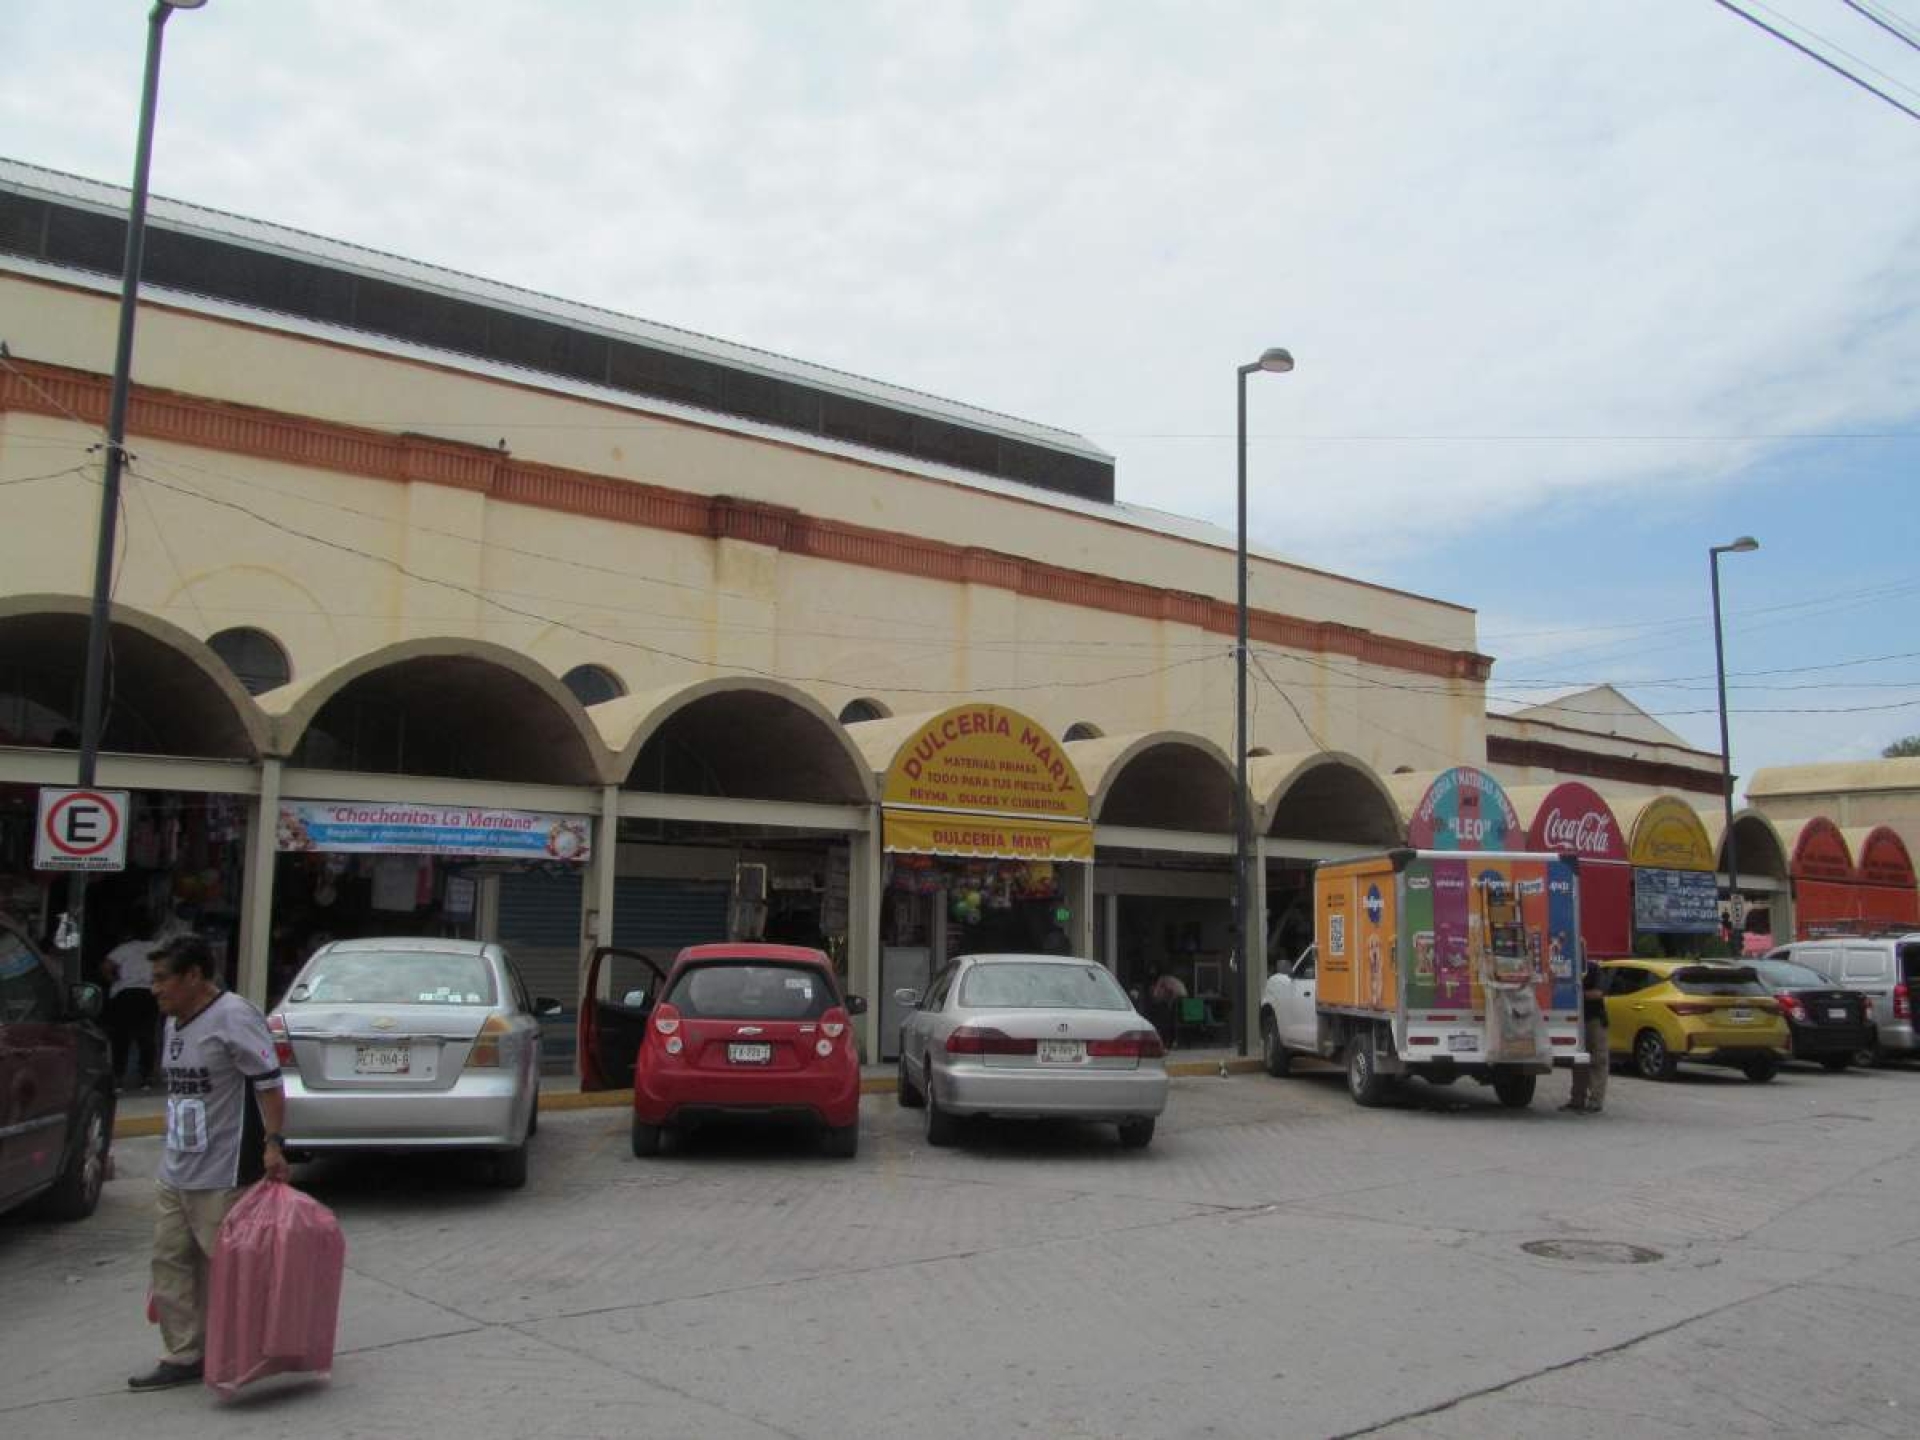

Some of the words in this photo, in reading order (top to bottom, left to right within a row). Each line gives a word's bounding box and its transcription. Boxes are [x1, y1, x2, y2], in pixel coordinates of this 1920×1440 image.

[903, 708, 1011, 780] DULCERÍA
[1019, 727, 1074, 792] MARY
[927, 773, 958, 784] TODO
[960, 776, 990, 787] PARA
[67, 806, 99, 842] E
[442, 809, 460, 826] La
[1012, 833, 1051, 849] MARY
